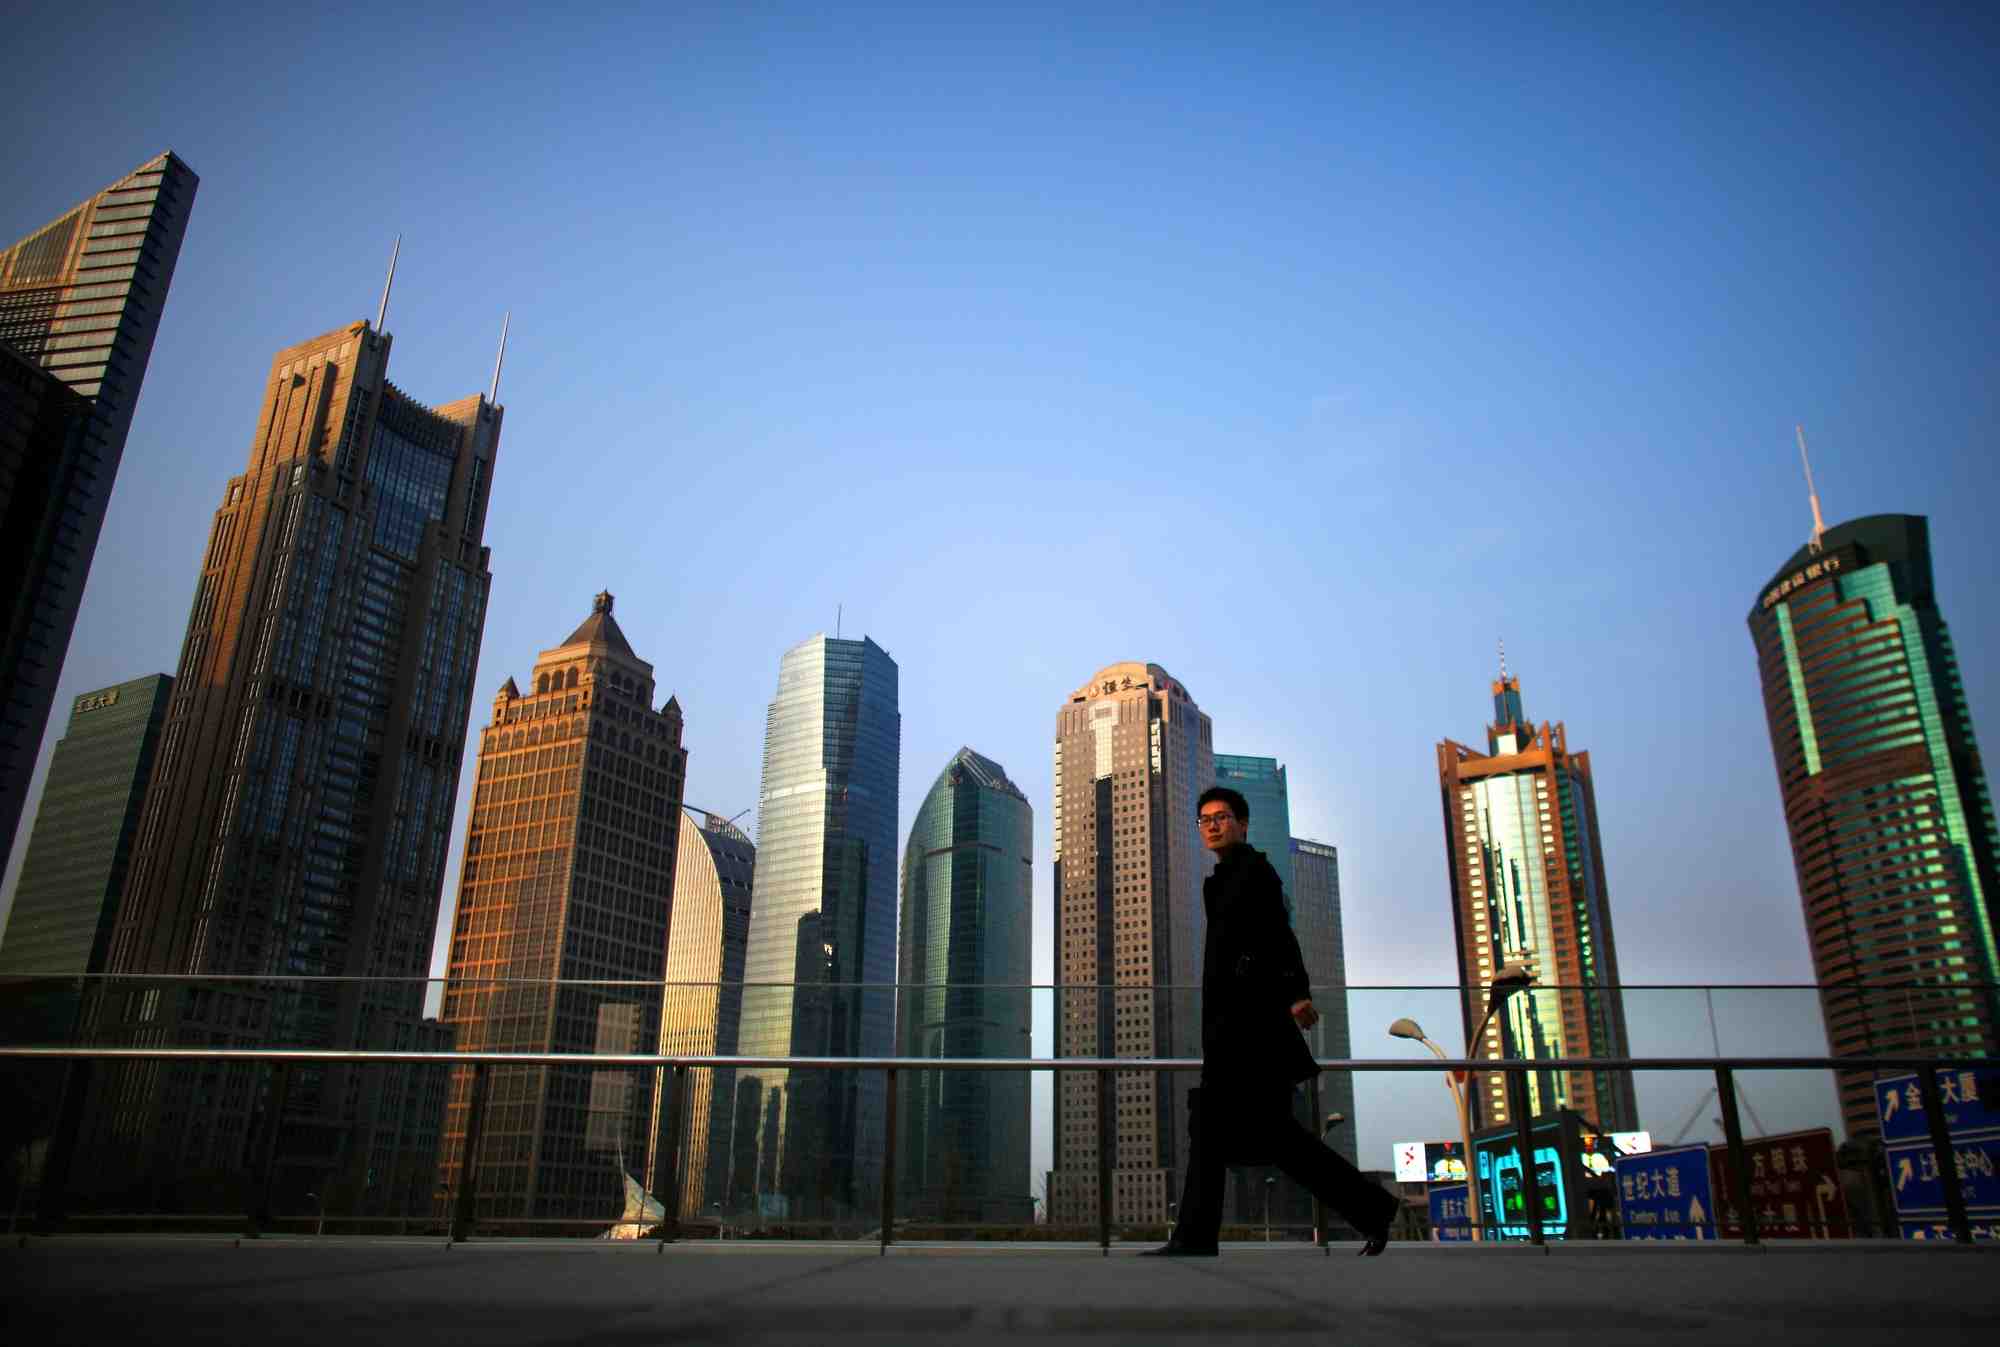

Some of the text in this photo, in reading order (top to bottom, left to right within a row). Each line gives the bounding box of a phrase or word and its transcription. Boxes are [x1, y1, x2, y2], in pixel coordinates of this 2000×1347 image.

[1102, 674, 1135, 695] 恒生
[1904, 1072, 1980, 1112] 金大厦
[1750, 1145, 1808, 1179] 方明珠
[1621, 1166, 1682, 1200] 世纪大道
[1727, 1200, 1801, 1232] 金大厦
